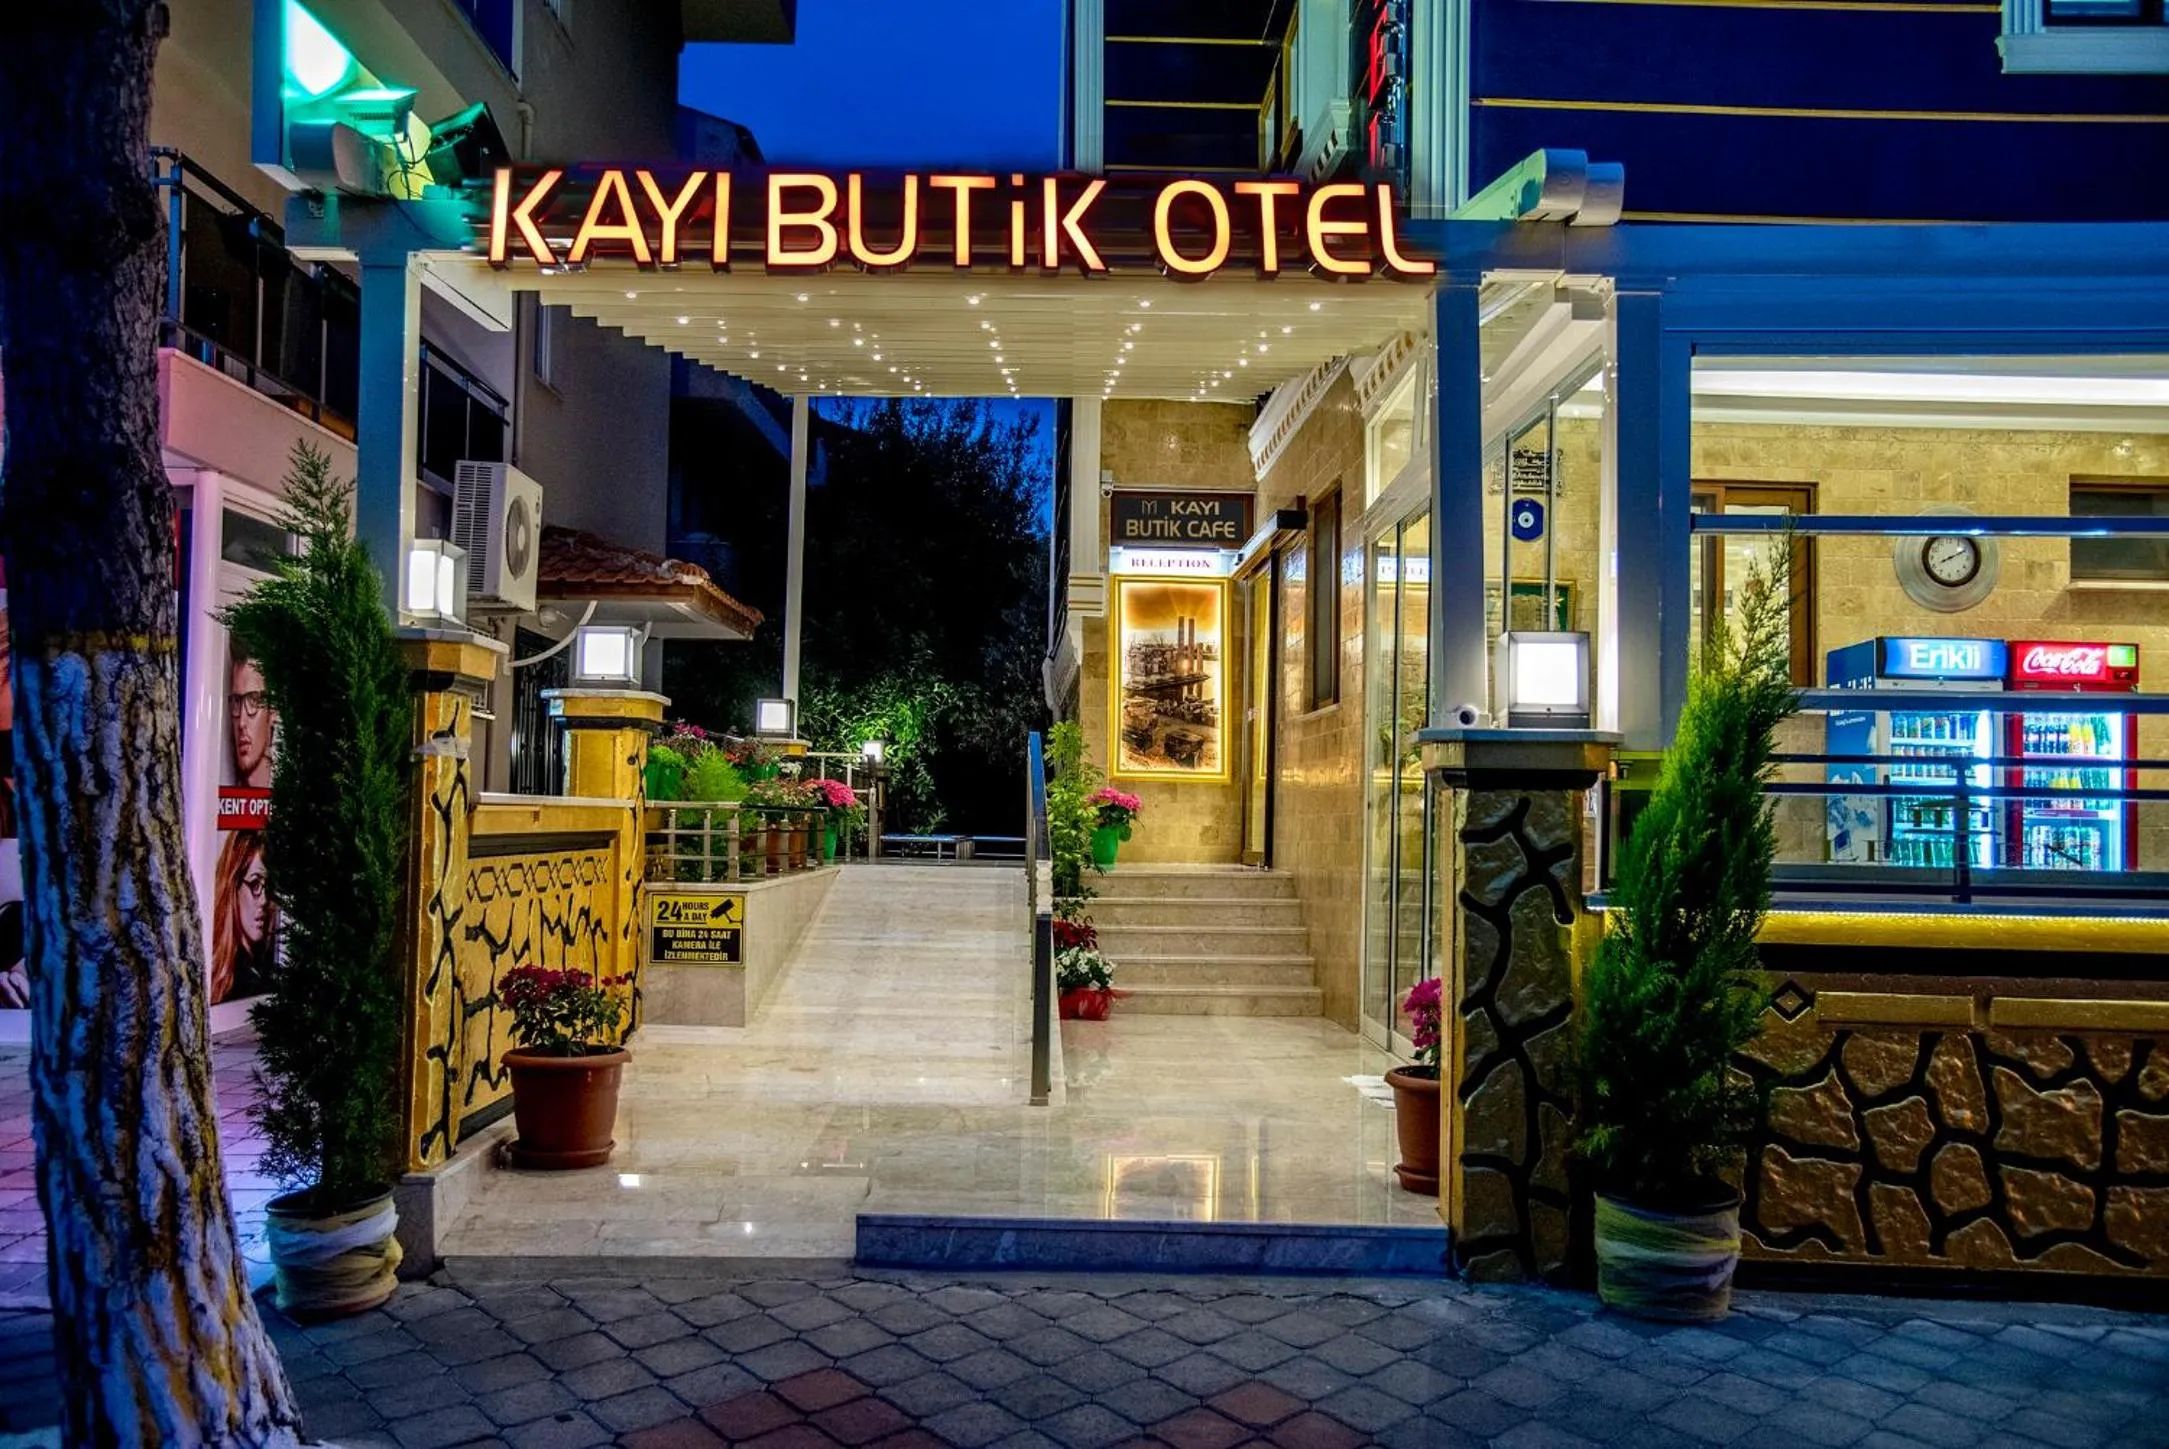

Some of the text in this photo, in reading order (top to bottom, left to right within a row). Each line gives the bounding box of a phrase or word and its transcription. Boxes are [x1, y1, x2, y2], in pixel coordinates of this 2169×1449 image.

[486, 168, 732, 266] KAYI
[1153, 179, 1437, 275] OTEL
[1170, 500, 1220, 515] KAYI
[1187, 520, 1236, 538] CAFE
[1131, 558, 1211, 568] RECEPTION
[657, 900, 709, 921] 24 HOURS
[683, 912, 707, 921] A DAY
[698, 930, 709, 939] 24
[710, 930, 732, 940] SAAT
[672, 940, 707, 950] KAMERA
